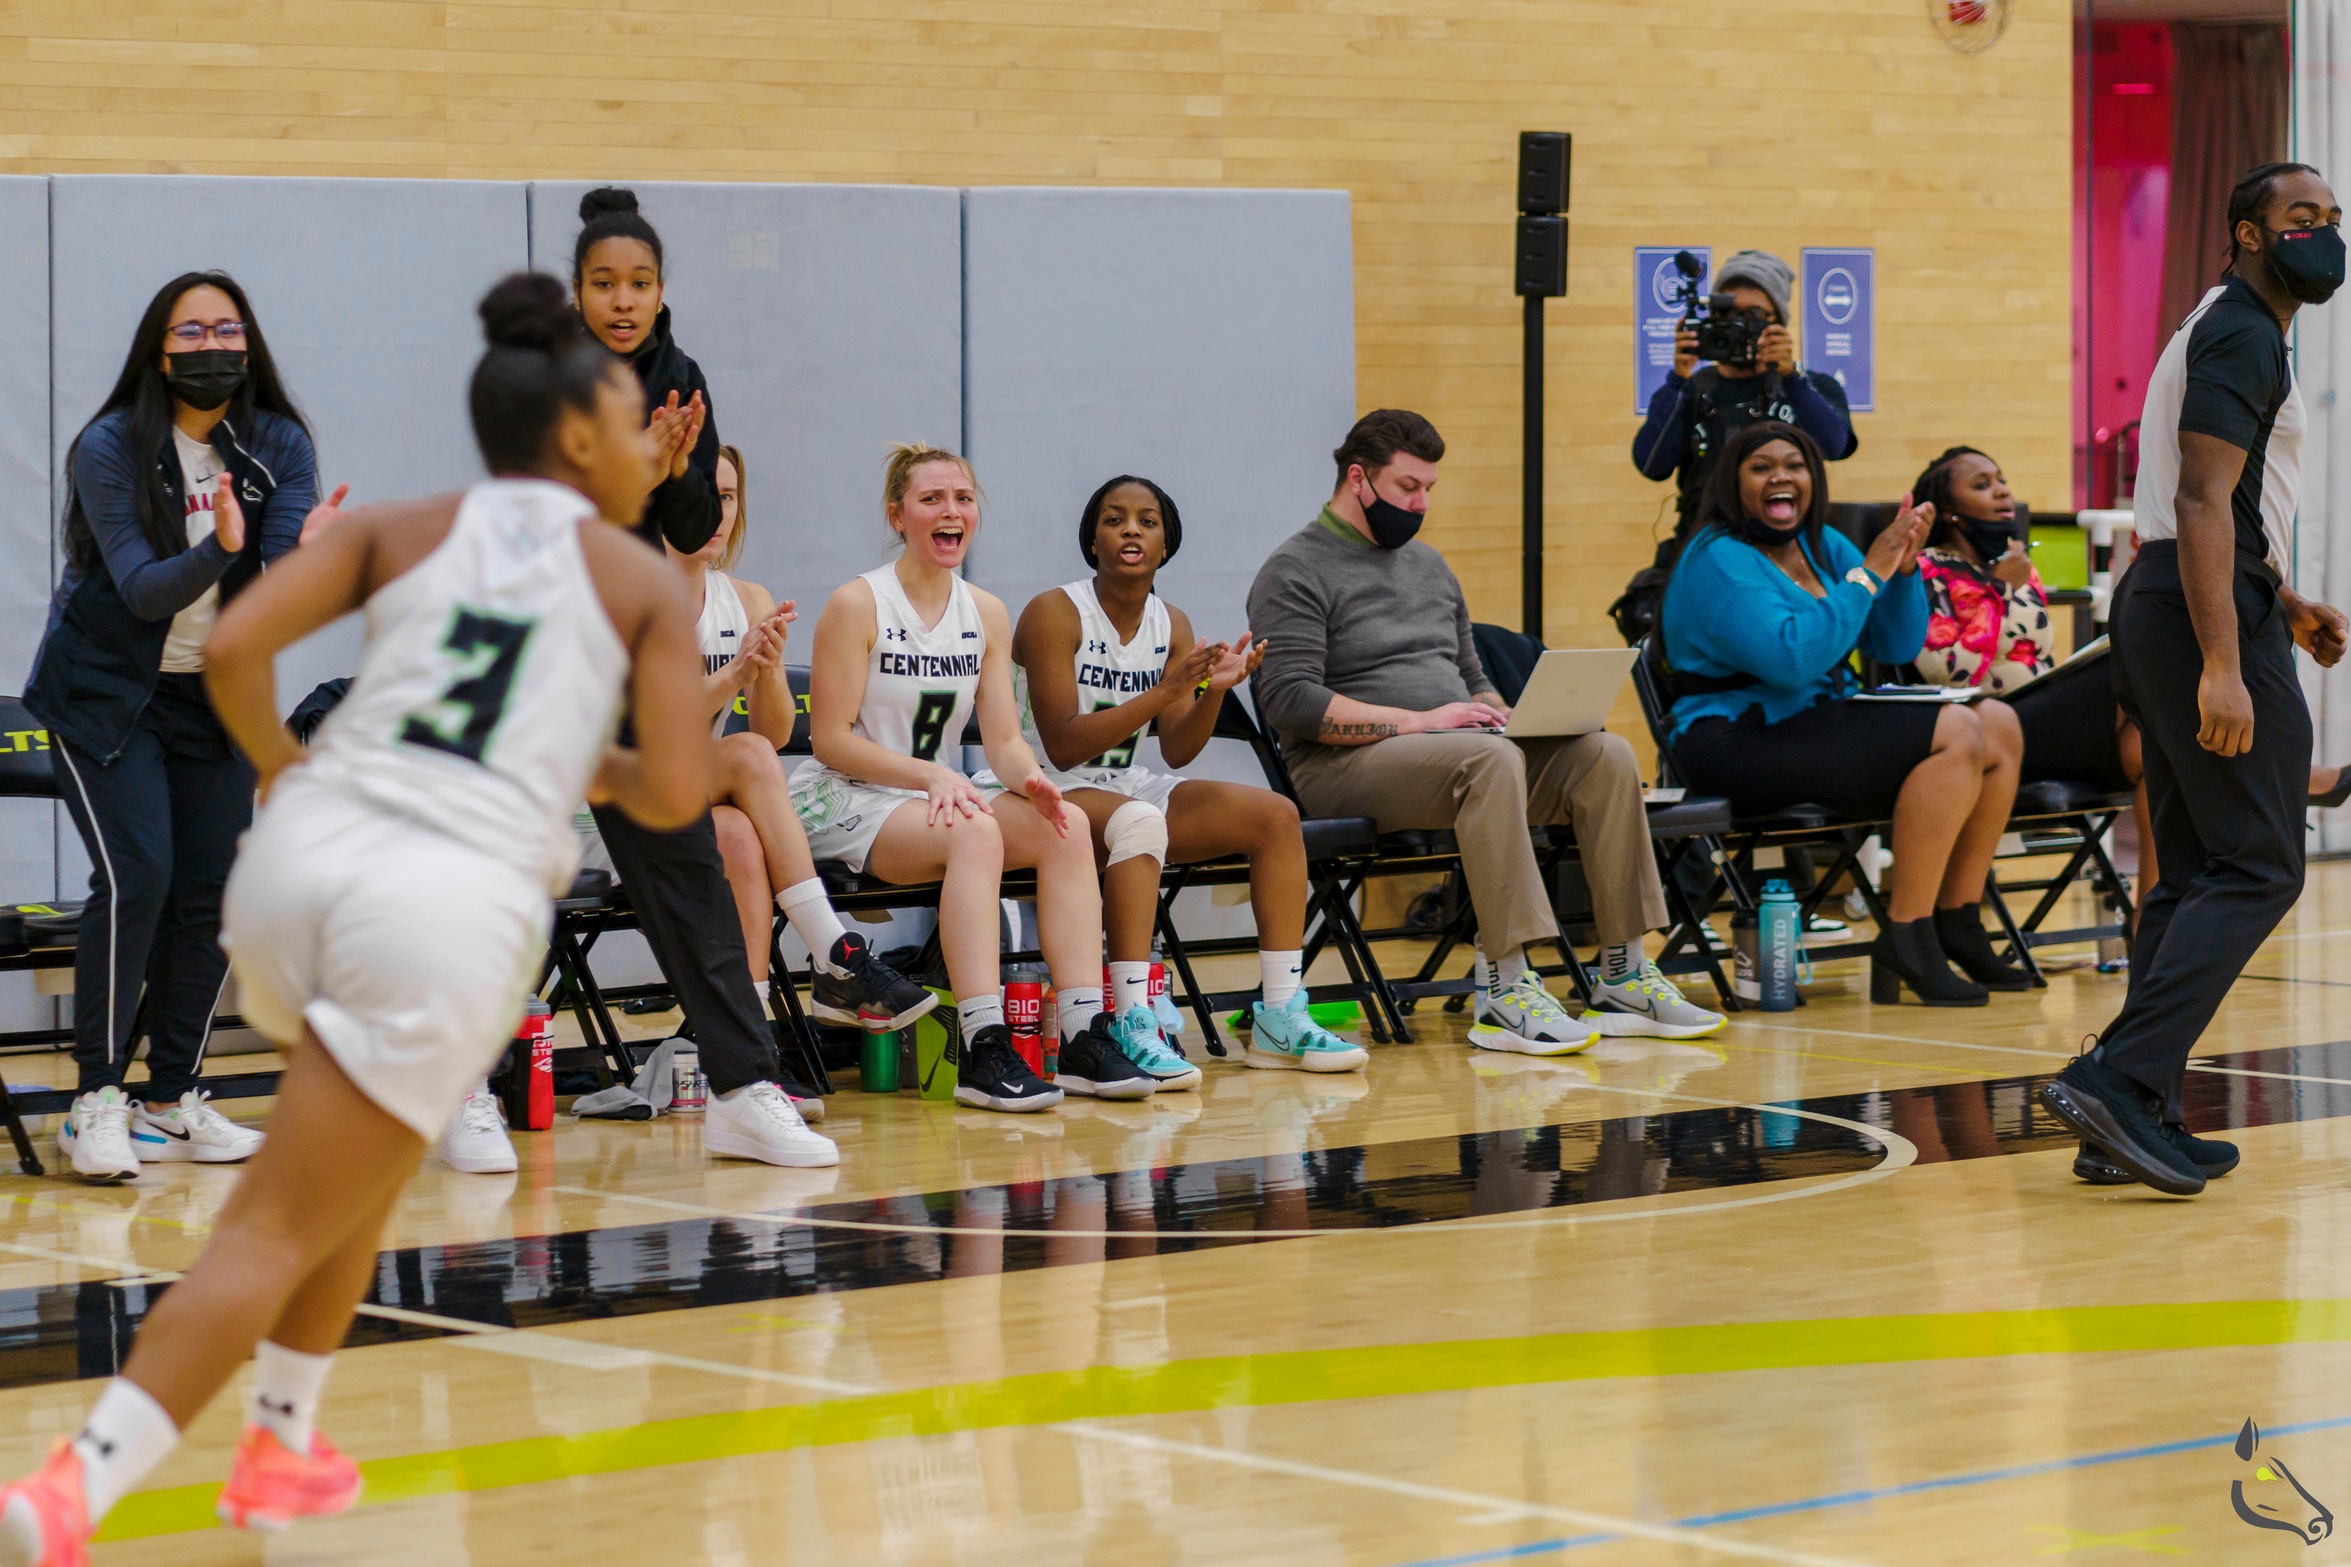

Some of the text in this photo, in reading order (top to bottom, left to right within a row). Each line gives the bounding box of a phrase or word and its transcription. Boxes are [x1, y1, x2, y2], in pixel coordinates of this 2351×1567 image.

[396, 602, 540, 766] 3
[879, 652, 980, 677] CENTENNIAL
[910, 689, 958, 763] 8
[1773, 919, 1787, 1000] HYDRATED
[1008, 999, 1040, 1014] BIO
